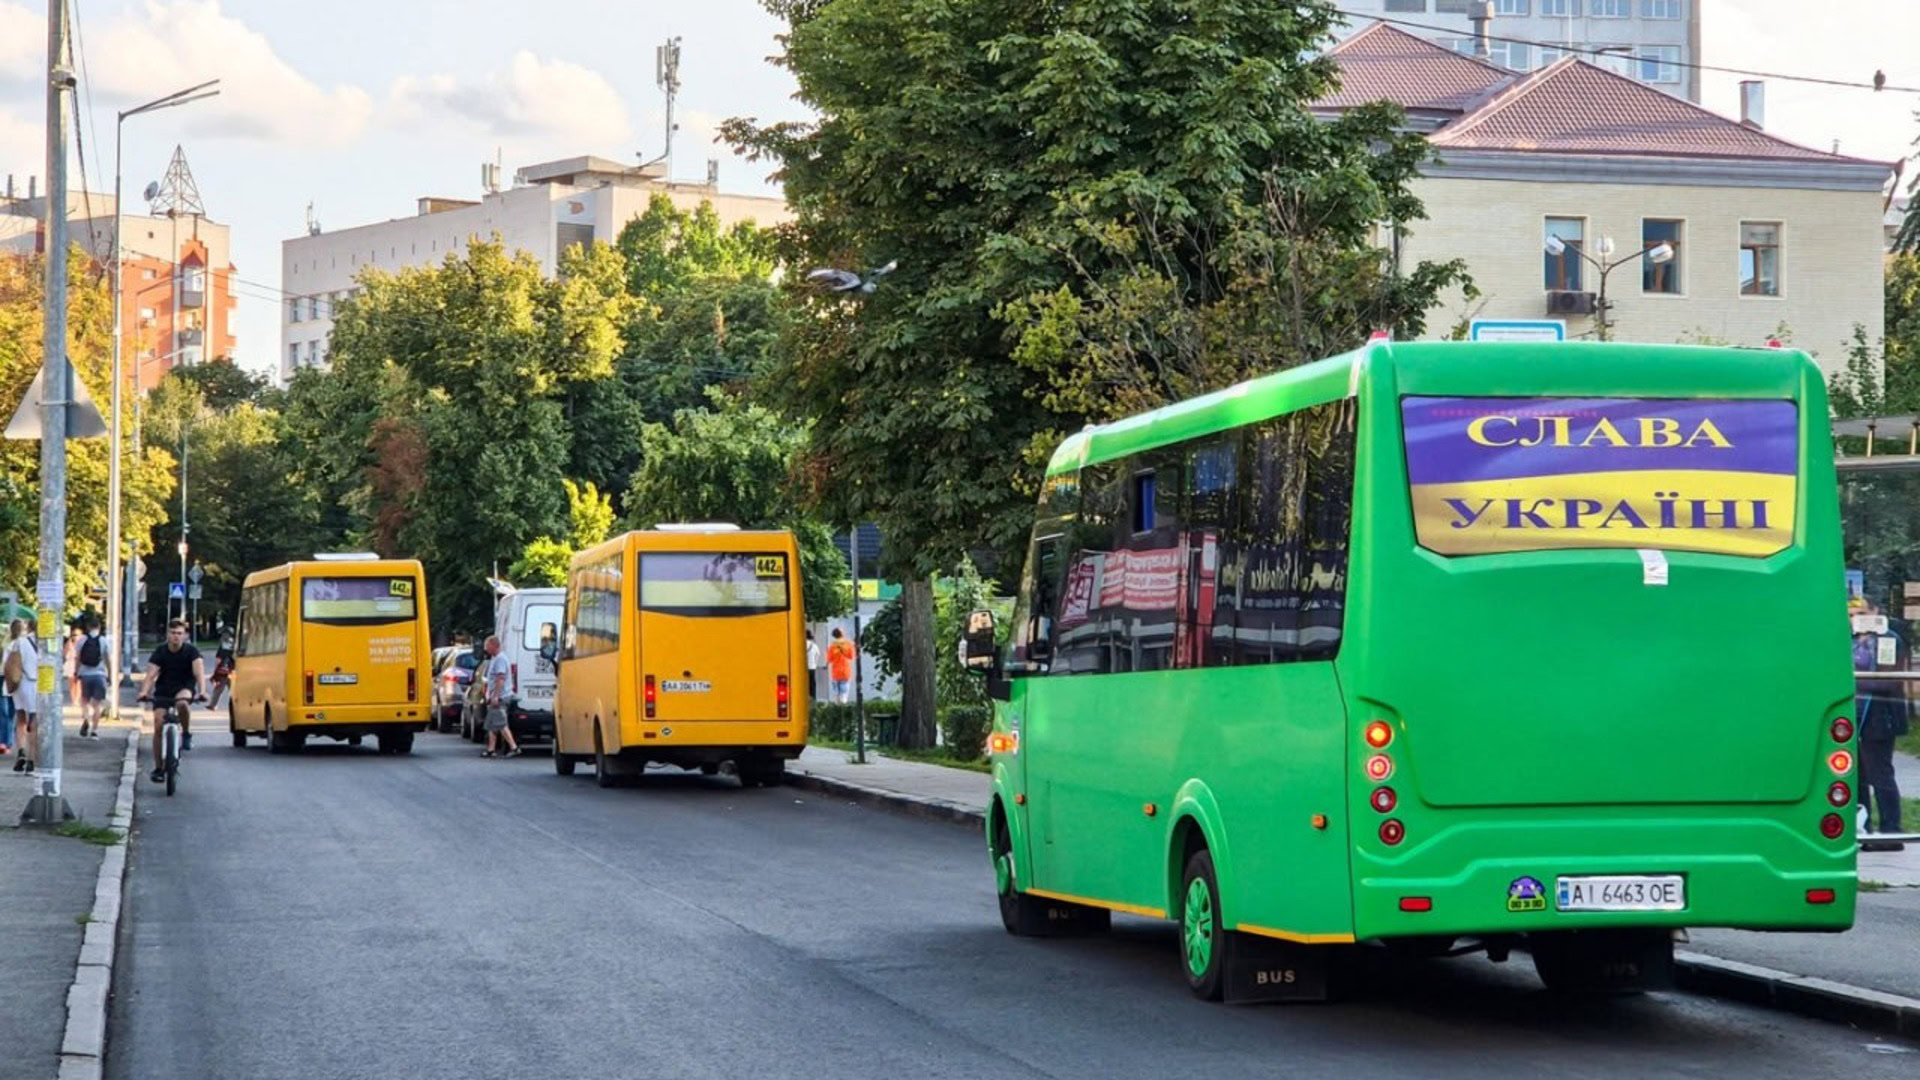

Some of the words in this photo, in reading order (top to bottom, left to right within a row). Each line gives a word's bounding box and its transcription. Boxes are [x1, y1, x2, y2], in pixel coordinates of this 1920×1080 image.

[1466, 415, 1735, 448] СЛАВА
[1442, 491, 1773, 530] УКРАЇНІ
[1572, 885, 1594, 903] AI
[1602, 884, 1645, 903] 6463
[1650, 883, 1676, 903] OE
[1257, 970, 1296, 984] BUS
